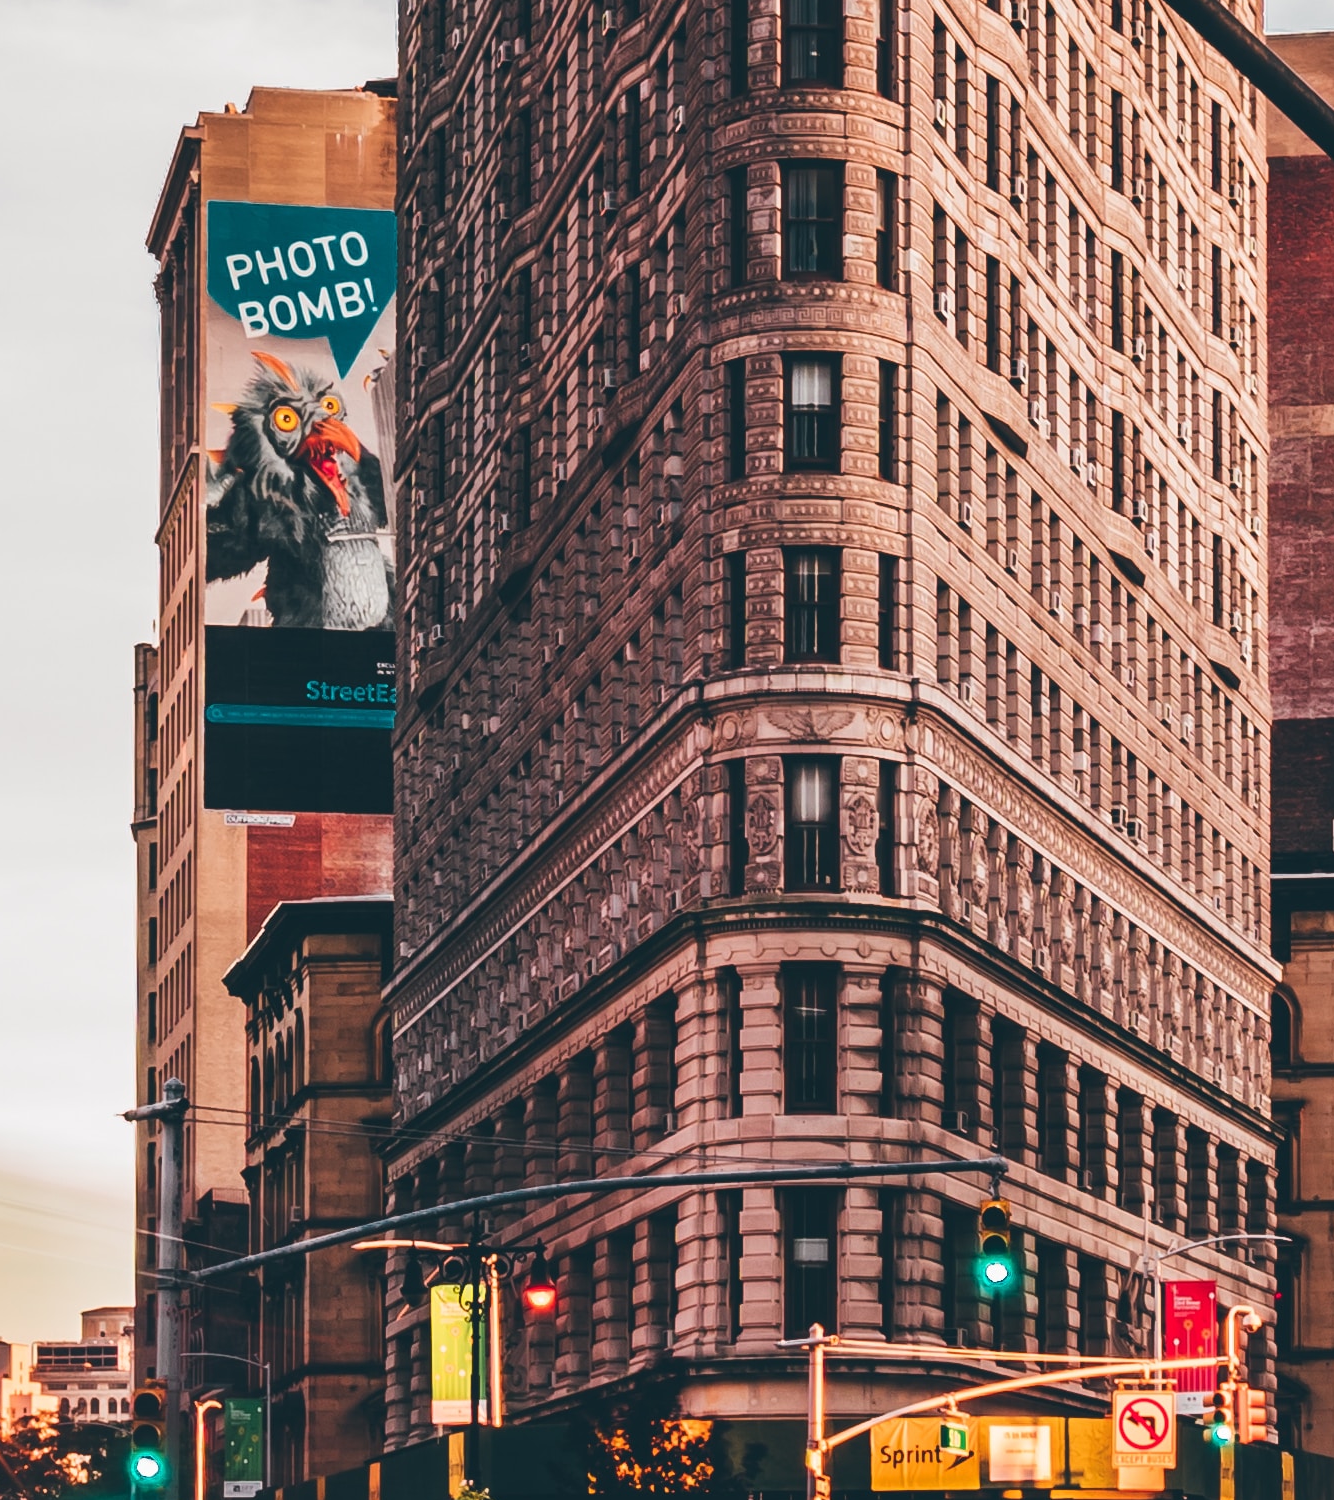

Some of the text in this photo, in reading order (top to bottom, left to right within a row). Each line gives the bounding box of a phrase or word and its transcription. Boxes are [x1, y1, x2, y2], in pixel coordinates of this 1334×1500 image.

[226, 231, 369, 291] PHOTO
[238, 277, 379, 339] BOMB!
[880, 1445, 943, 1469] Sprint
[1116, 1454, 1172, 1464] EXCEPT BUSES
